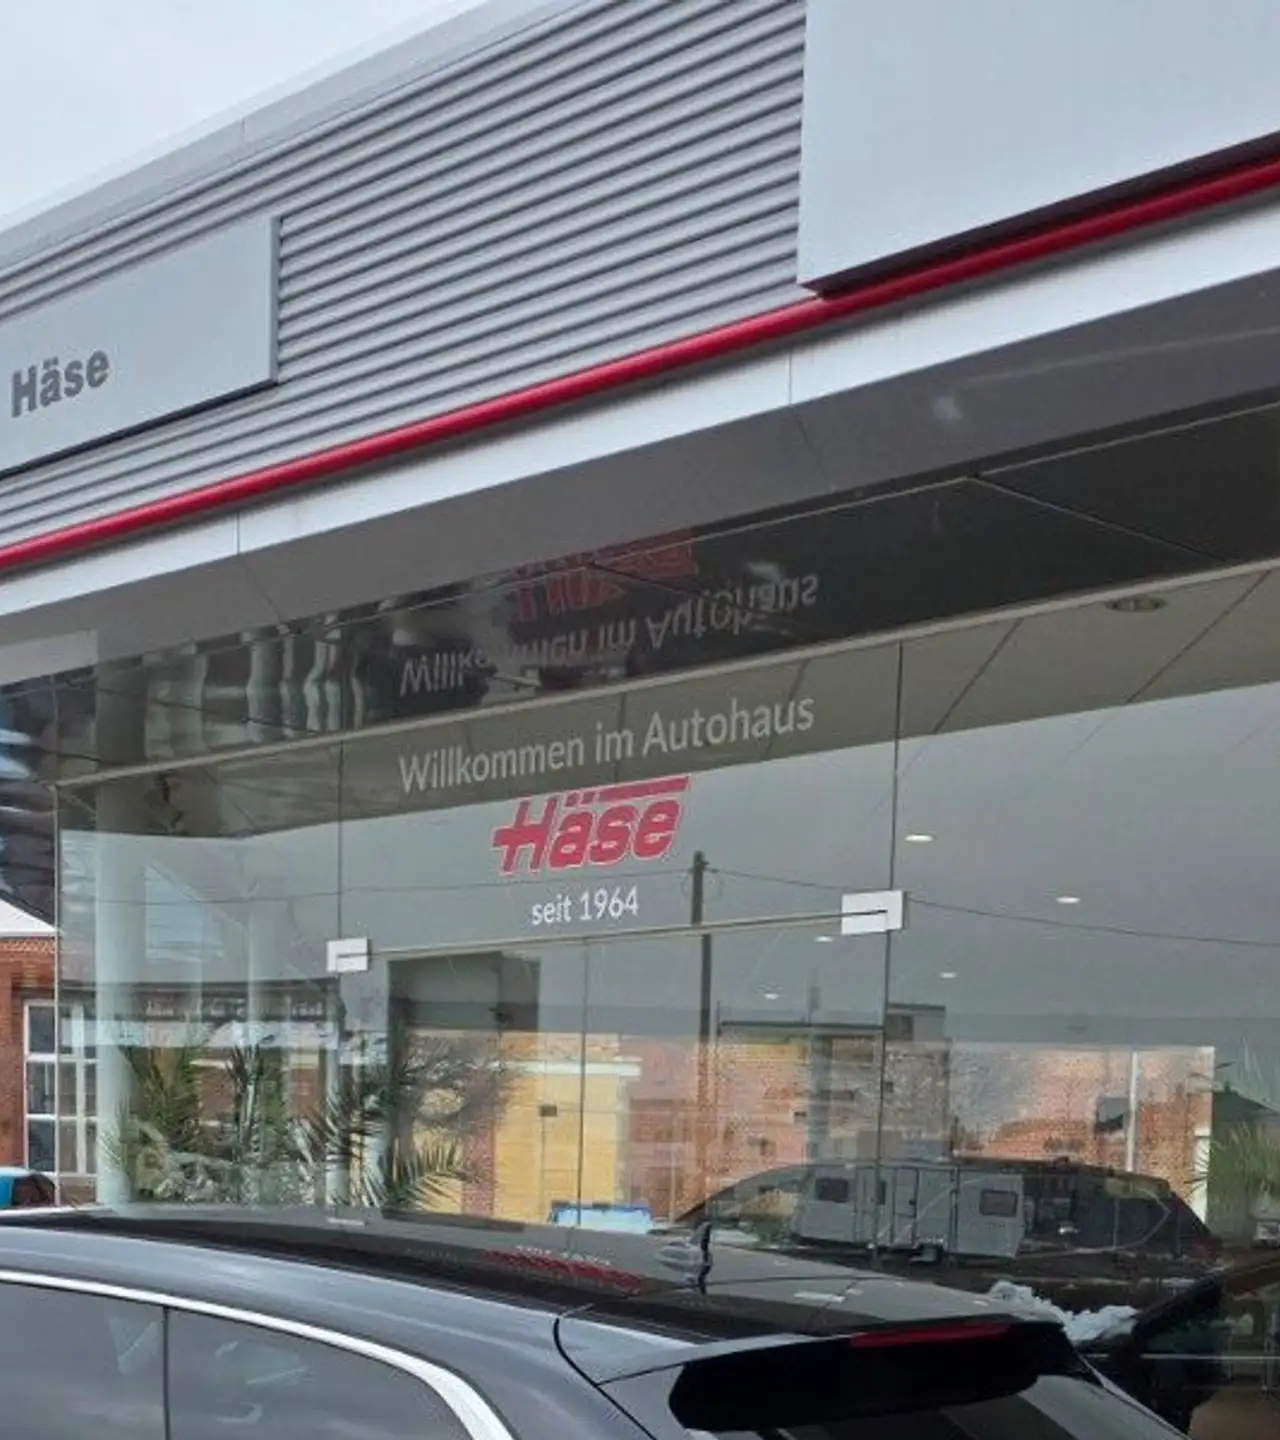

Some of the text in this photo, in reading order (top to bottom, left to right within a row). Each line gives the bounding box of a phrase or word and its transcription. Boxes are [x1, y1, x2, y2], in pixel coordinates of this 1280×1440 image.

[11, 350, 109, 418] Häse
[397, 697, 815, 793] Willkommen im Autohaus
[492, 774, 691, 876] Häse
[532, 886, 639, 925] seit 1964
